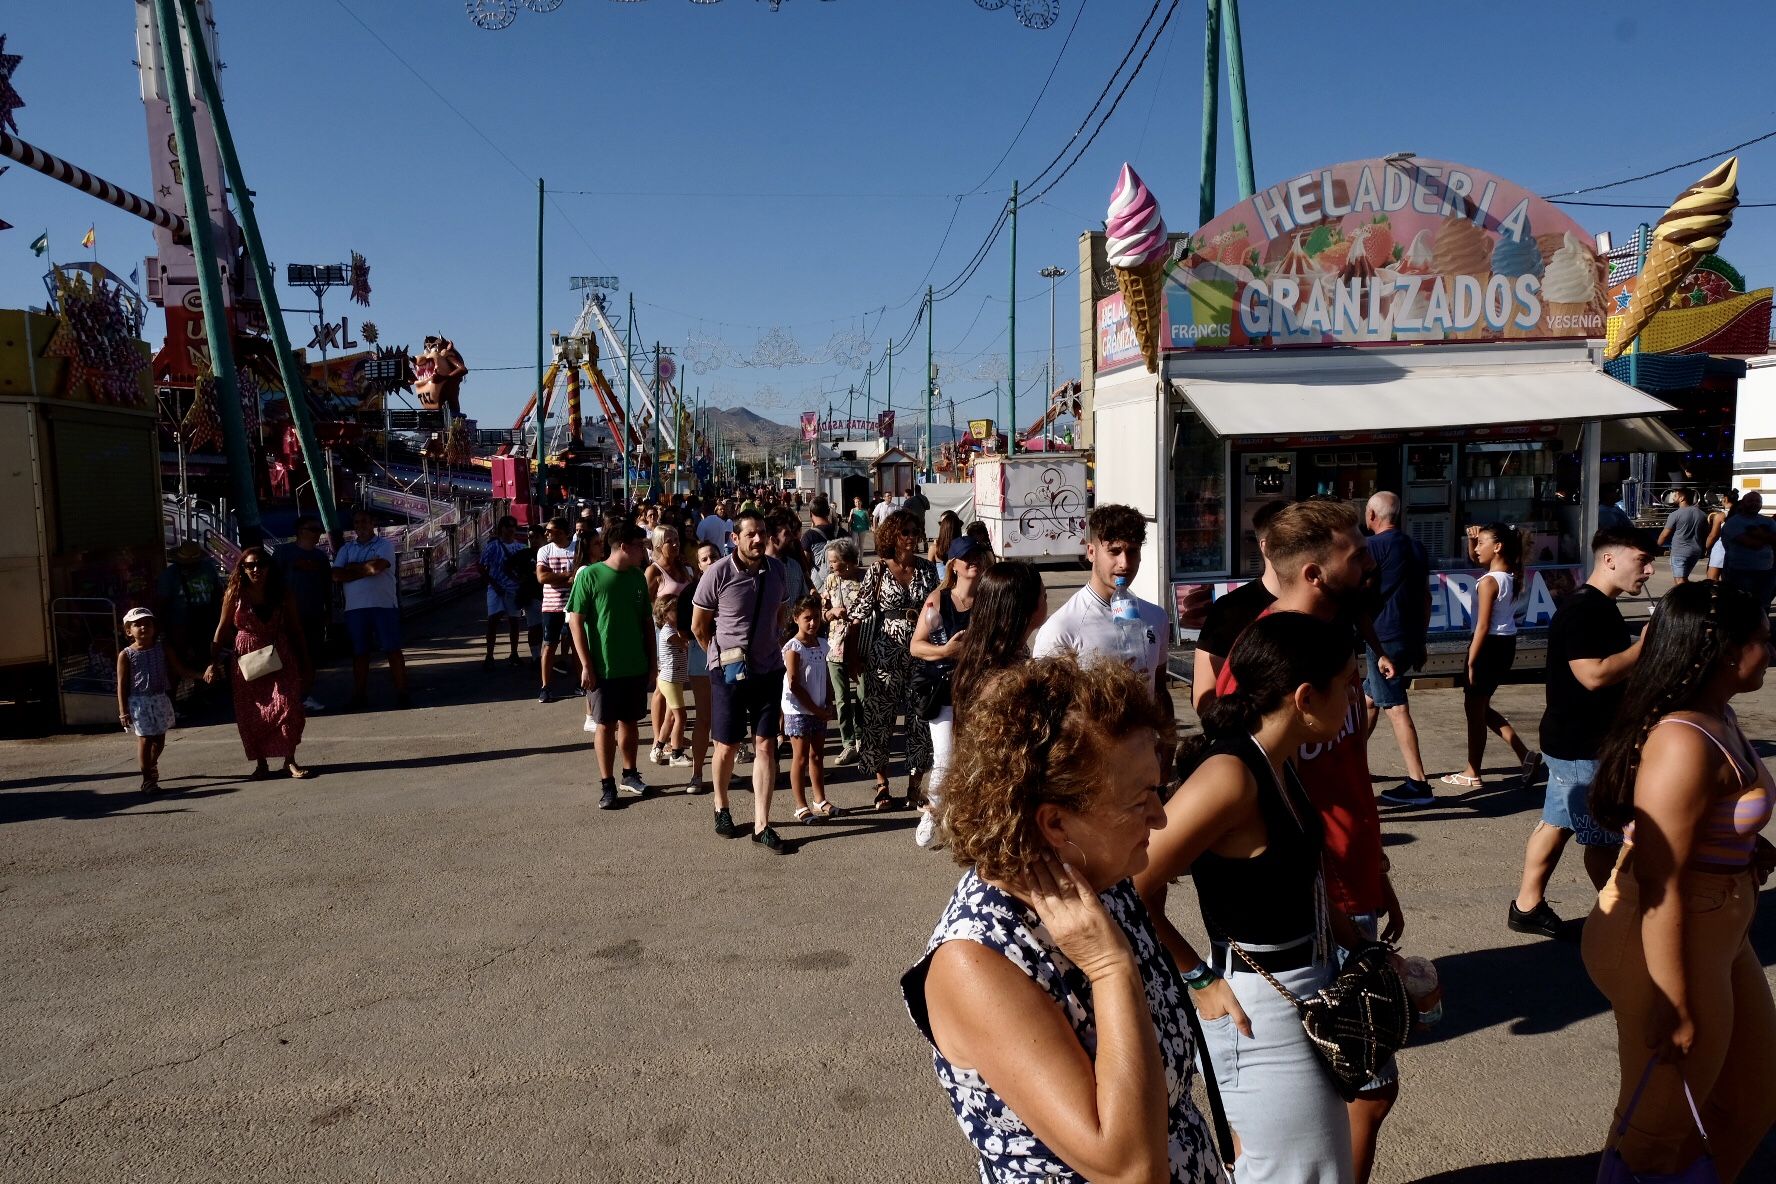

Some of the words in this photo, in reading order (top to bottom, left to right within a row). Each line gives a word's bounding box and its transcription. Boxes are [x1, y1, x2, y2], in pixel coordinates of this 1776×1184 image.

[1252, 165, 1529, 243] HELADERIA
[1240, 273, 1542, 337] GRANIZADOS
[1546, 314, 1602, 329] YESENIA
[307, 316, 358, 351] XXL
[1171, 323, 1231, 339] FRANCIS
